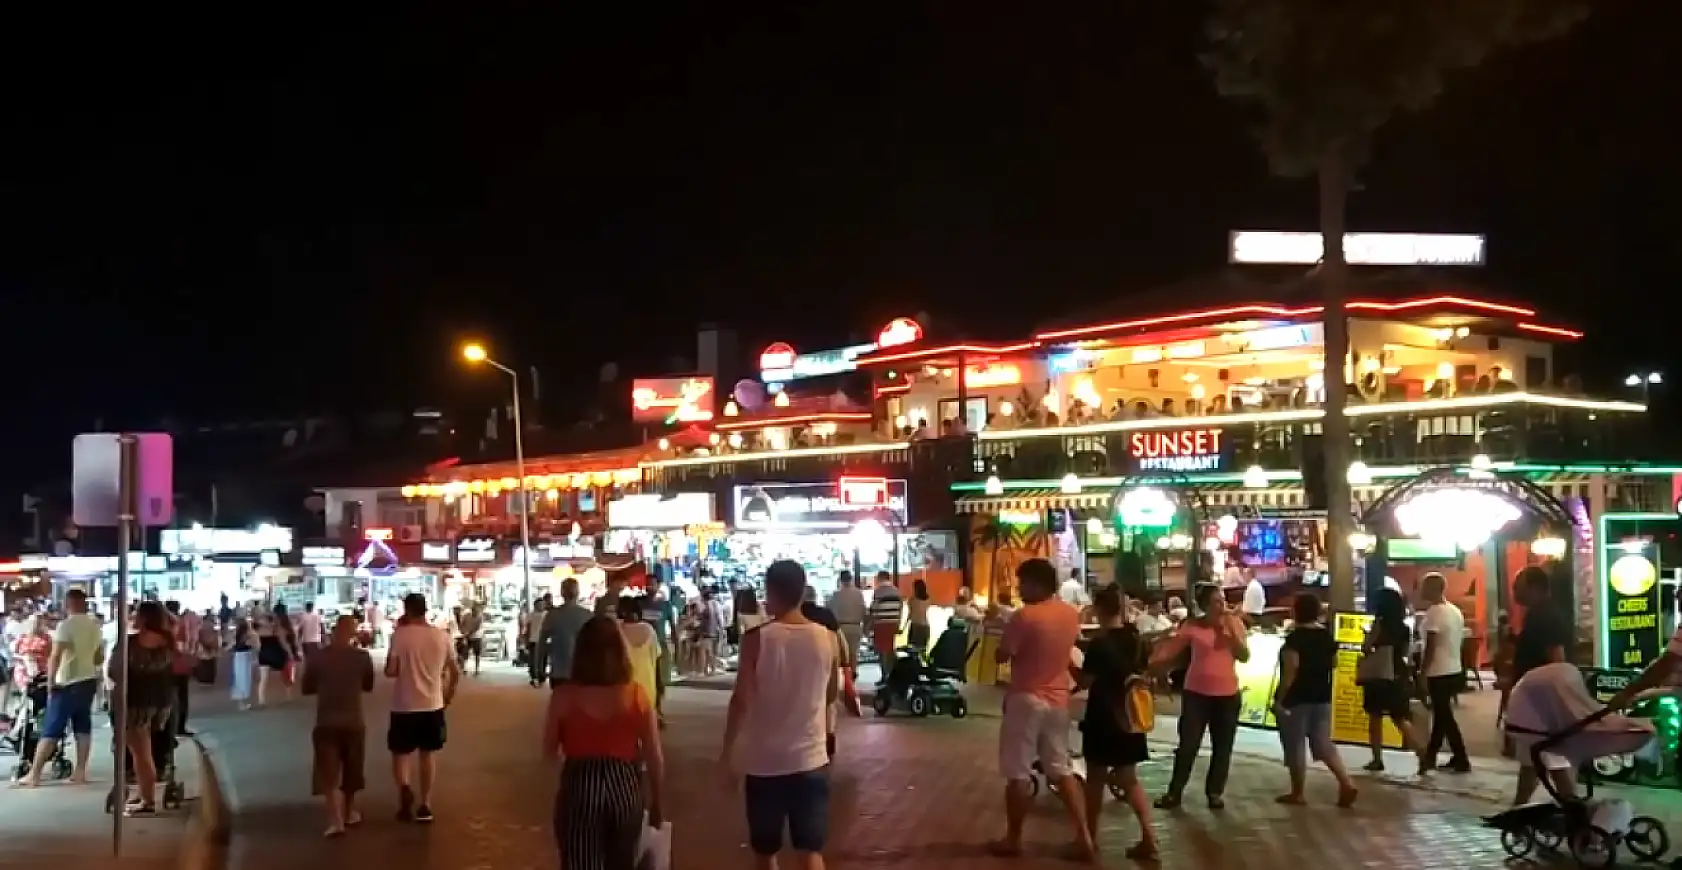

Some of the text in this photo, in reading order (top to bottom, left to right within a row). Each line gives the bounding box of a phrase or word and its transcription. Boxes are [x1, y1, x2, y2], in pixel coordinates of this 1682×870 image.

[1131, 429, 1222, 457] SUNSET
[1139, 454, 1220, 471] RESTAURANT
[1617, 598, 1648, 612] CHEERS
[1610, 615, 1655, 630] RESTAURANT
[1623, 650, 1642, 664] BAR
